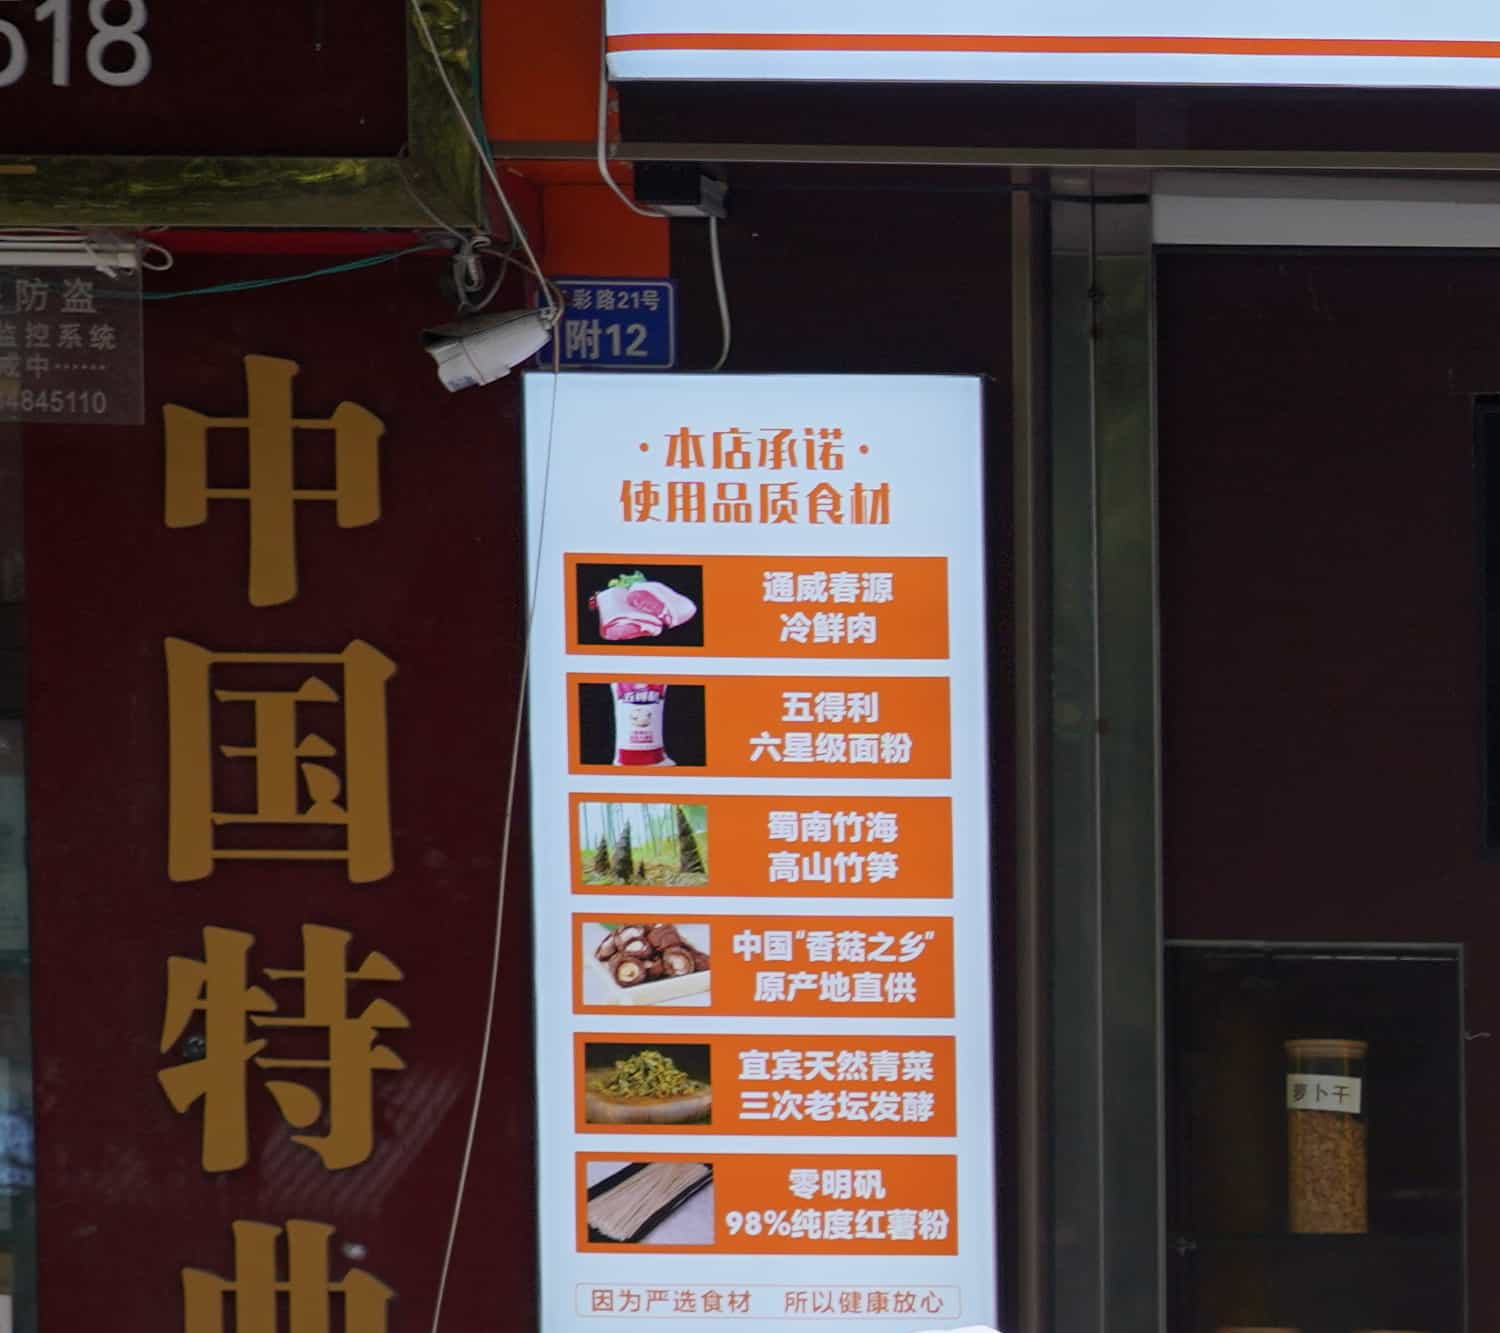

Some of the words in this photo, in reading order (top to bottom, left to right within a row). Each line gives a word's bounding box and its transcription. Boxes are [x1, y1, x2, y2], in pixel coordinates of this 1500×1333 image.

[16, 277, 97, 313] 防盗
[561, 288, 660, 312] 彩路21号
[565, 319, 648, 360] 附12
[664, 427, 845, 471] 本店承诺
[620, 480, 890, 525] 使用品质食材
[763, 571, 894, 604] 通威春源
[779, 612, 878, 644] 冷鲜肉
[781, 692, 880, 724] 五得利
[749, 731, 913, 764] 六星级面粉
[768, 810, 899, 843] 蜀南竹海
[768, 851, 898, 883] 高山竹笋
[754, 971, 917, 1003] 原产地直供
[738, 1050, 936, 1082] 宜宾天然青菜
[739, 1089, 936, 1122] 三次老坛发酵
[788, 1168, 887, 1200] 零明矾
[725, 1208, 950, 1241] 98%纯度红薯粉
[590, 1287, 753, 1315] 因为严选食材
[783, 1289, 945, 1315] 所以健康放心
